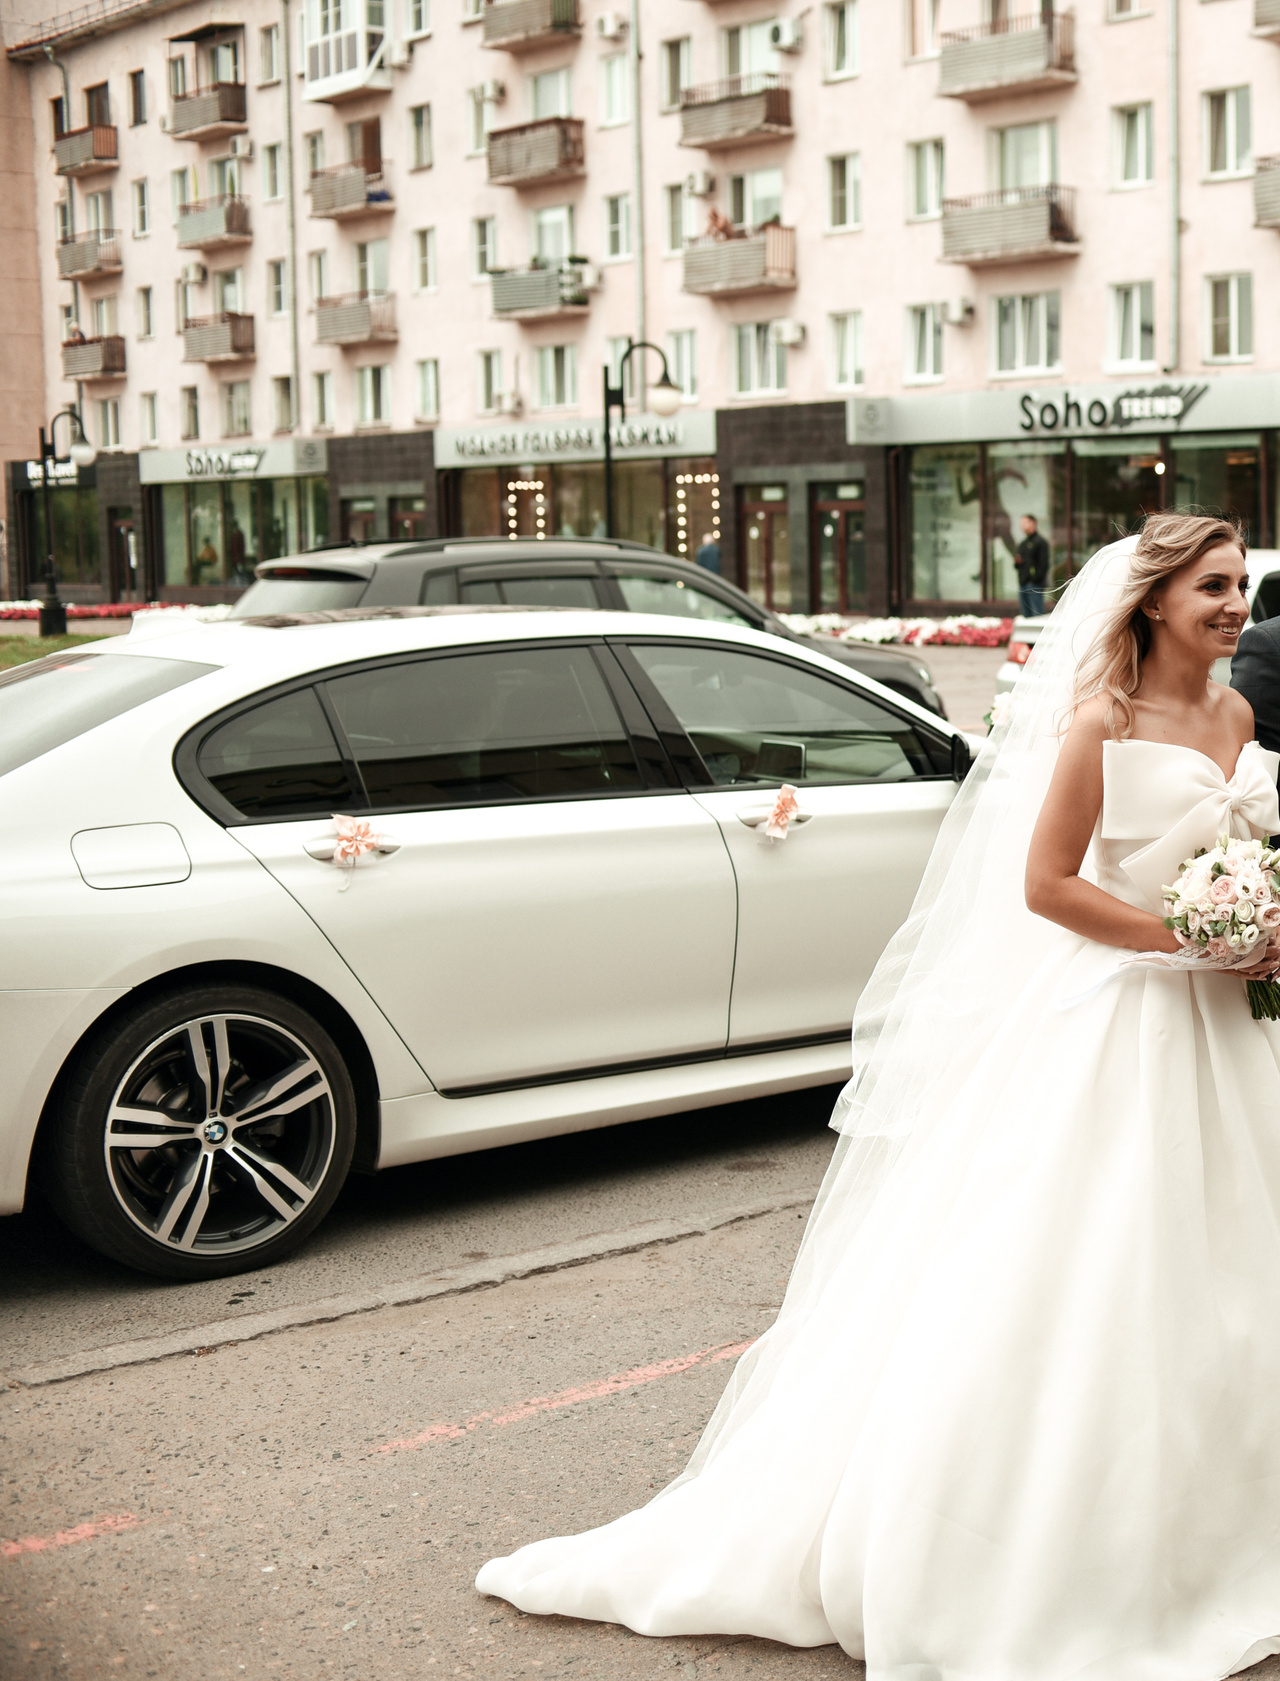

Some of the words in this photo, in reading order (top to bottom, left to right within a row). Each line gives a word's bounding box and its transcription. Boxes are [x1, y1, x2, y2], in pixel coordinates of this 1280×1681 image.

[1021, 391, 1108, 431] Soho
[1119, 396, 1184, 419] TREND
[186, 448, 224, 475] Soho
